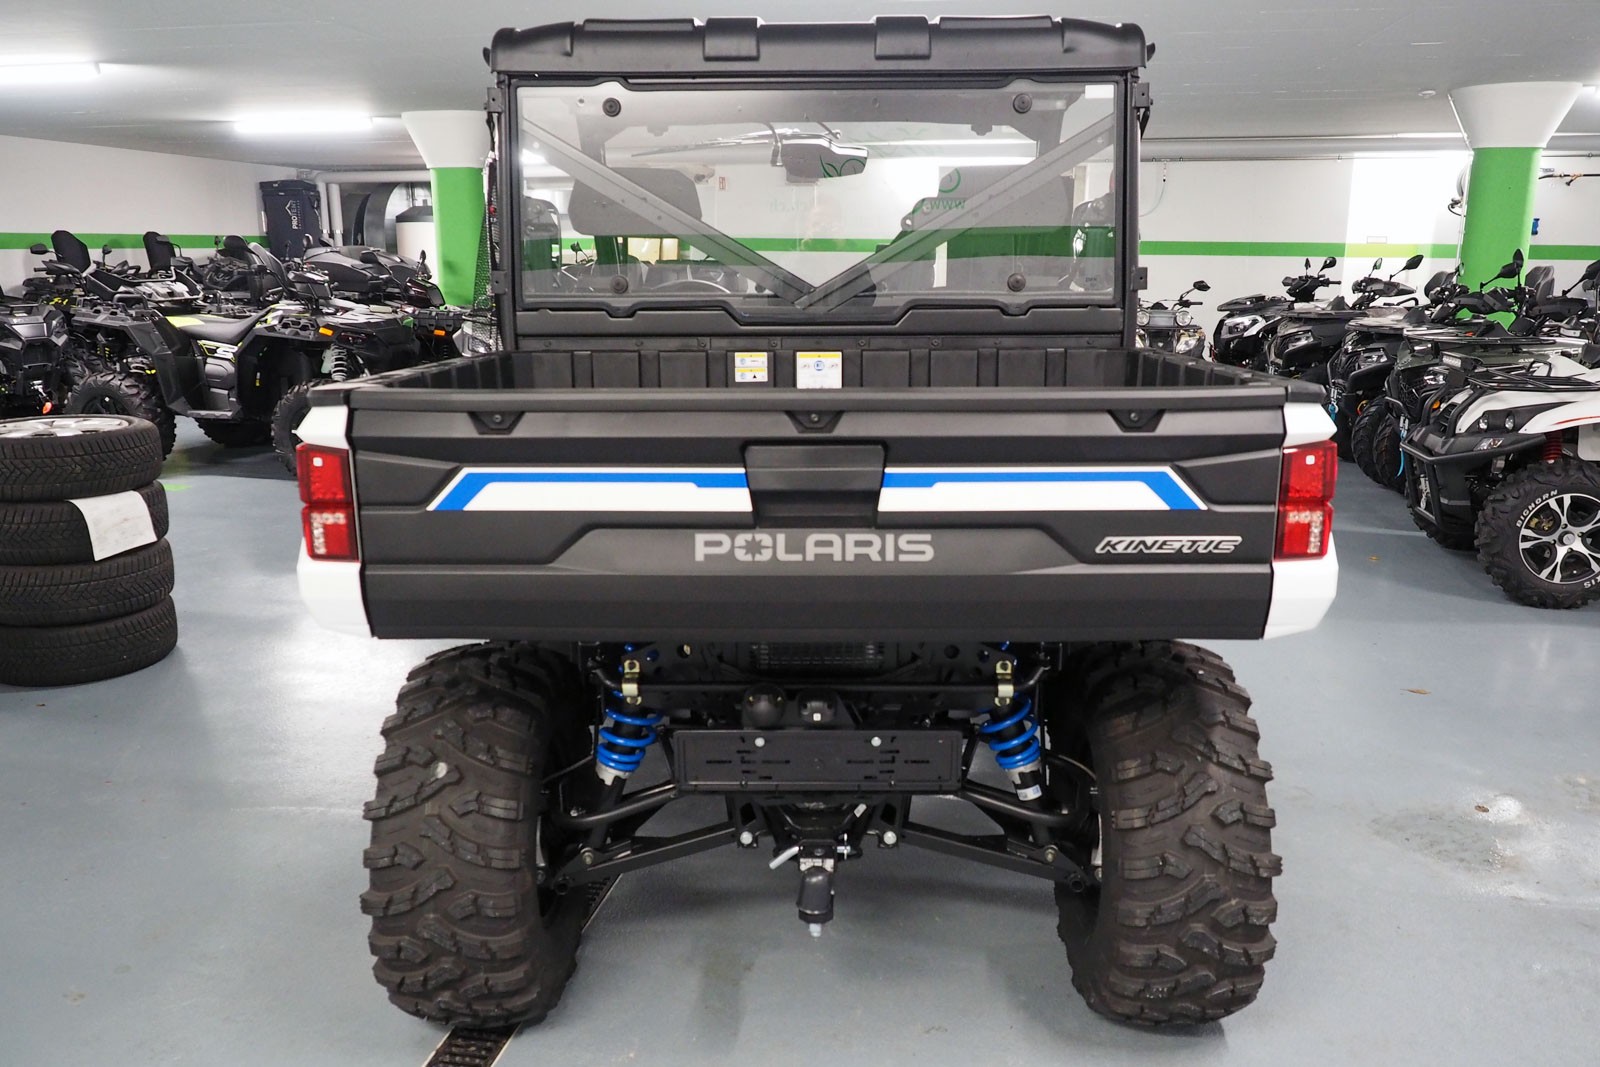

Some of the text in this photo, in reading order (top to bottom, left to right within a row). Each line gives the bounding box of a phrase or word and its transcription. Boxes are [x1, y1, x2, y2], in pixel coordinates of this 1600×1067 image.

[1516, 489, 1558, 528] BIGHORN
[694, 533, 935, 562] POLARIS
[1095, 535, 1243, 554] KINETIC
